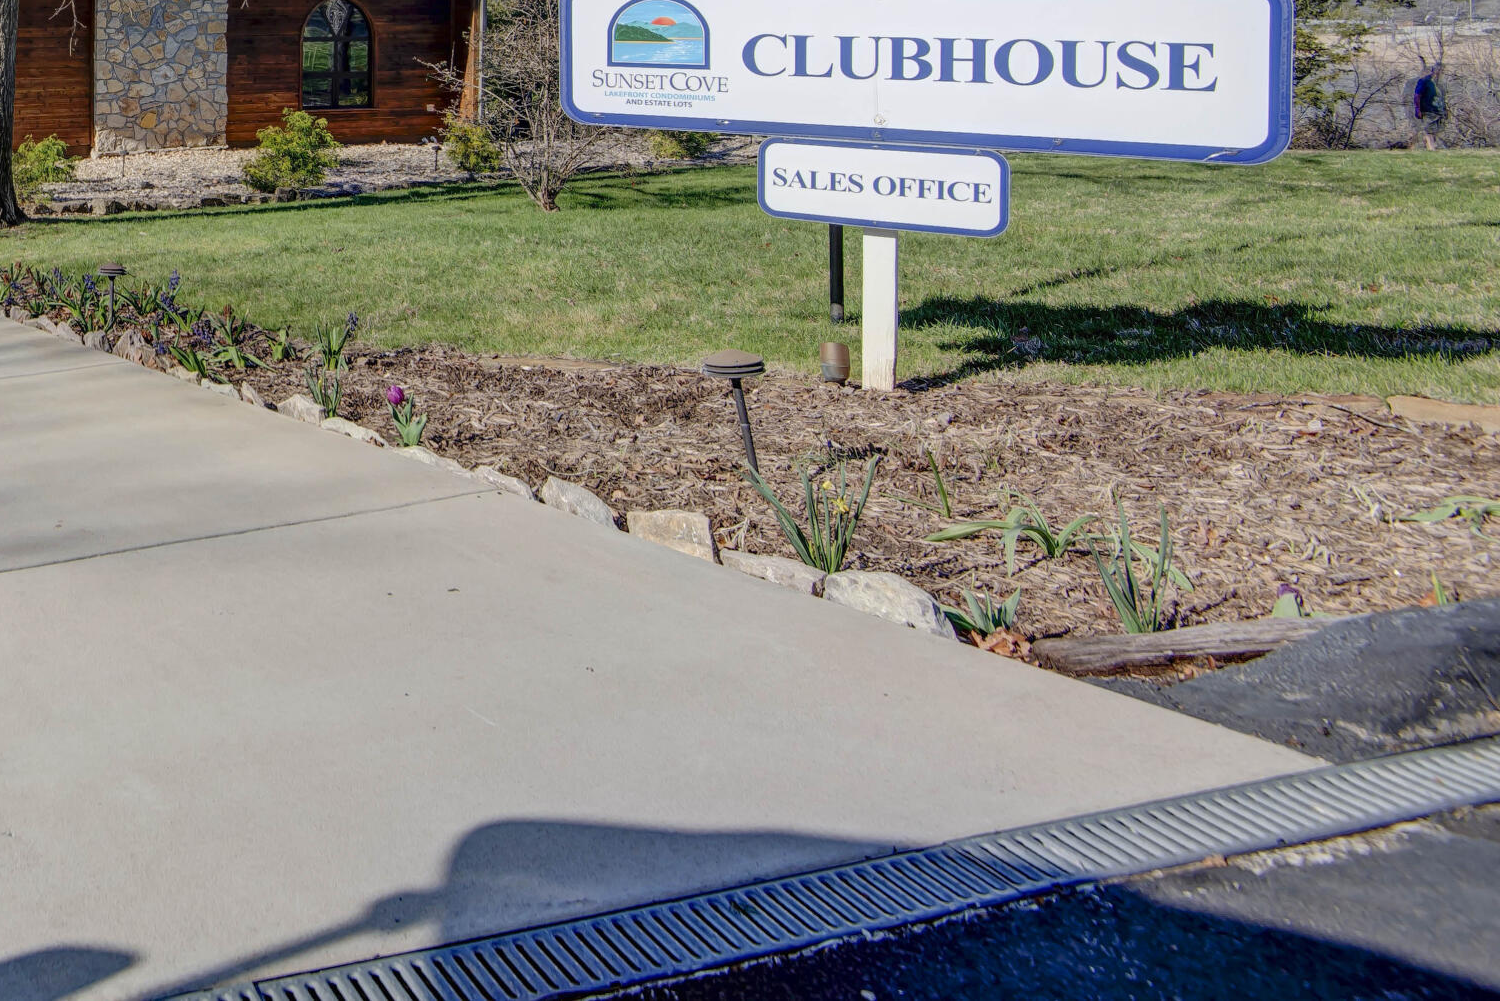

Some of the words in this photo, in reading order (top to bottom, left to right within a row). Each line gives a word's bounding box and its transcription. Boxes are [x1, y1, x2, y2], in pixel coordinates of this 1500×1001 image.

[742, 33, 1218, 92] CLUBHOUSE
[592, 69, 667, 90] SUNSET
[669, 72, 729, 93] COVE
[604, 90, 648, 98] LAKEFRONT
[651, 92, 716, 101] CONDOMINIUMS
[773, 167, 864, 194] SALES
[873, 175, 992, 204] OFFICE
